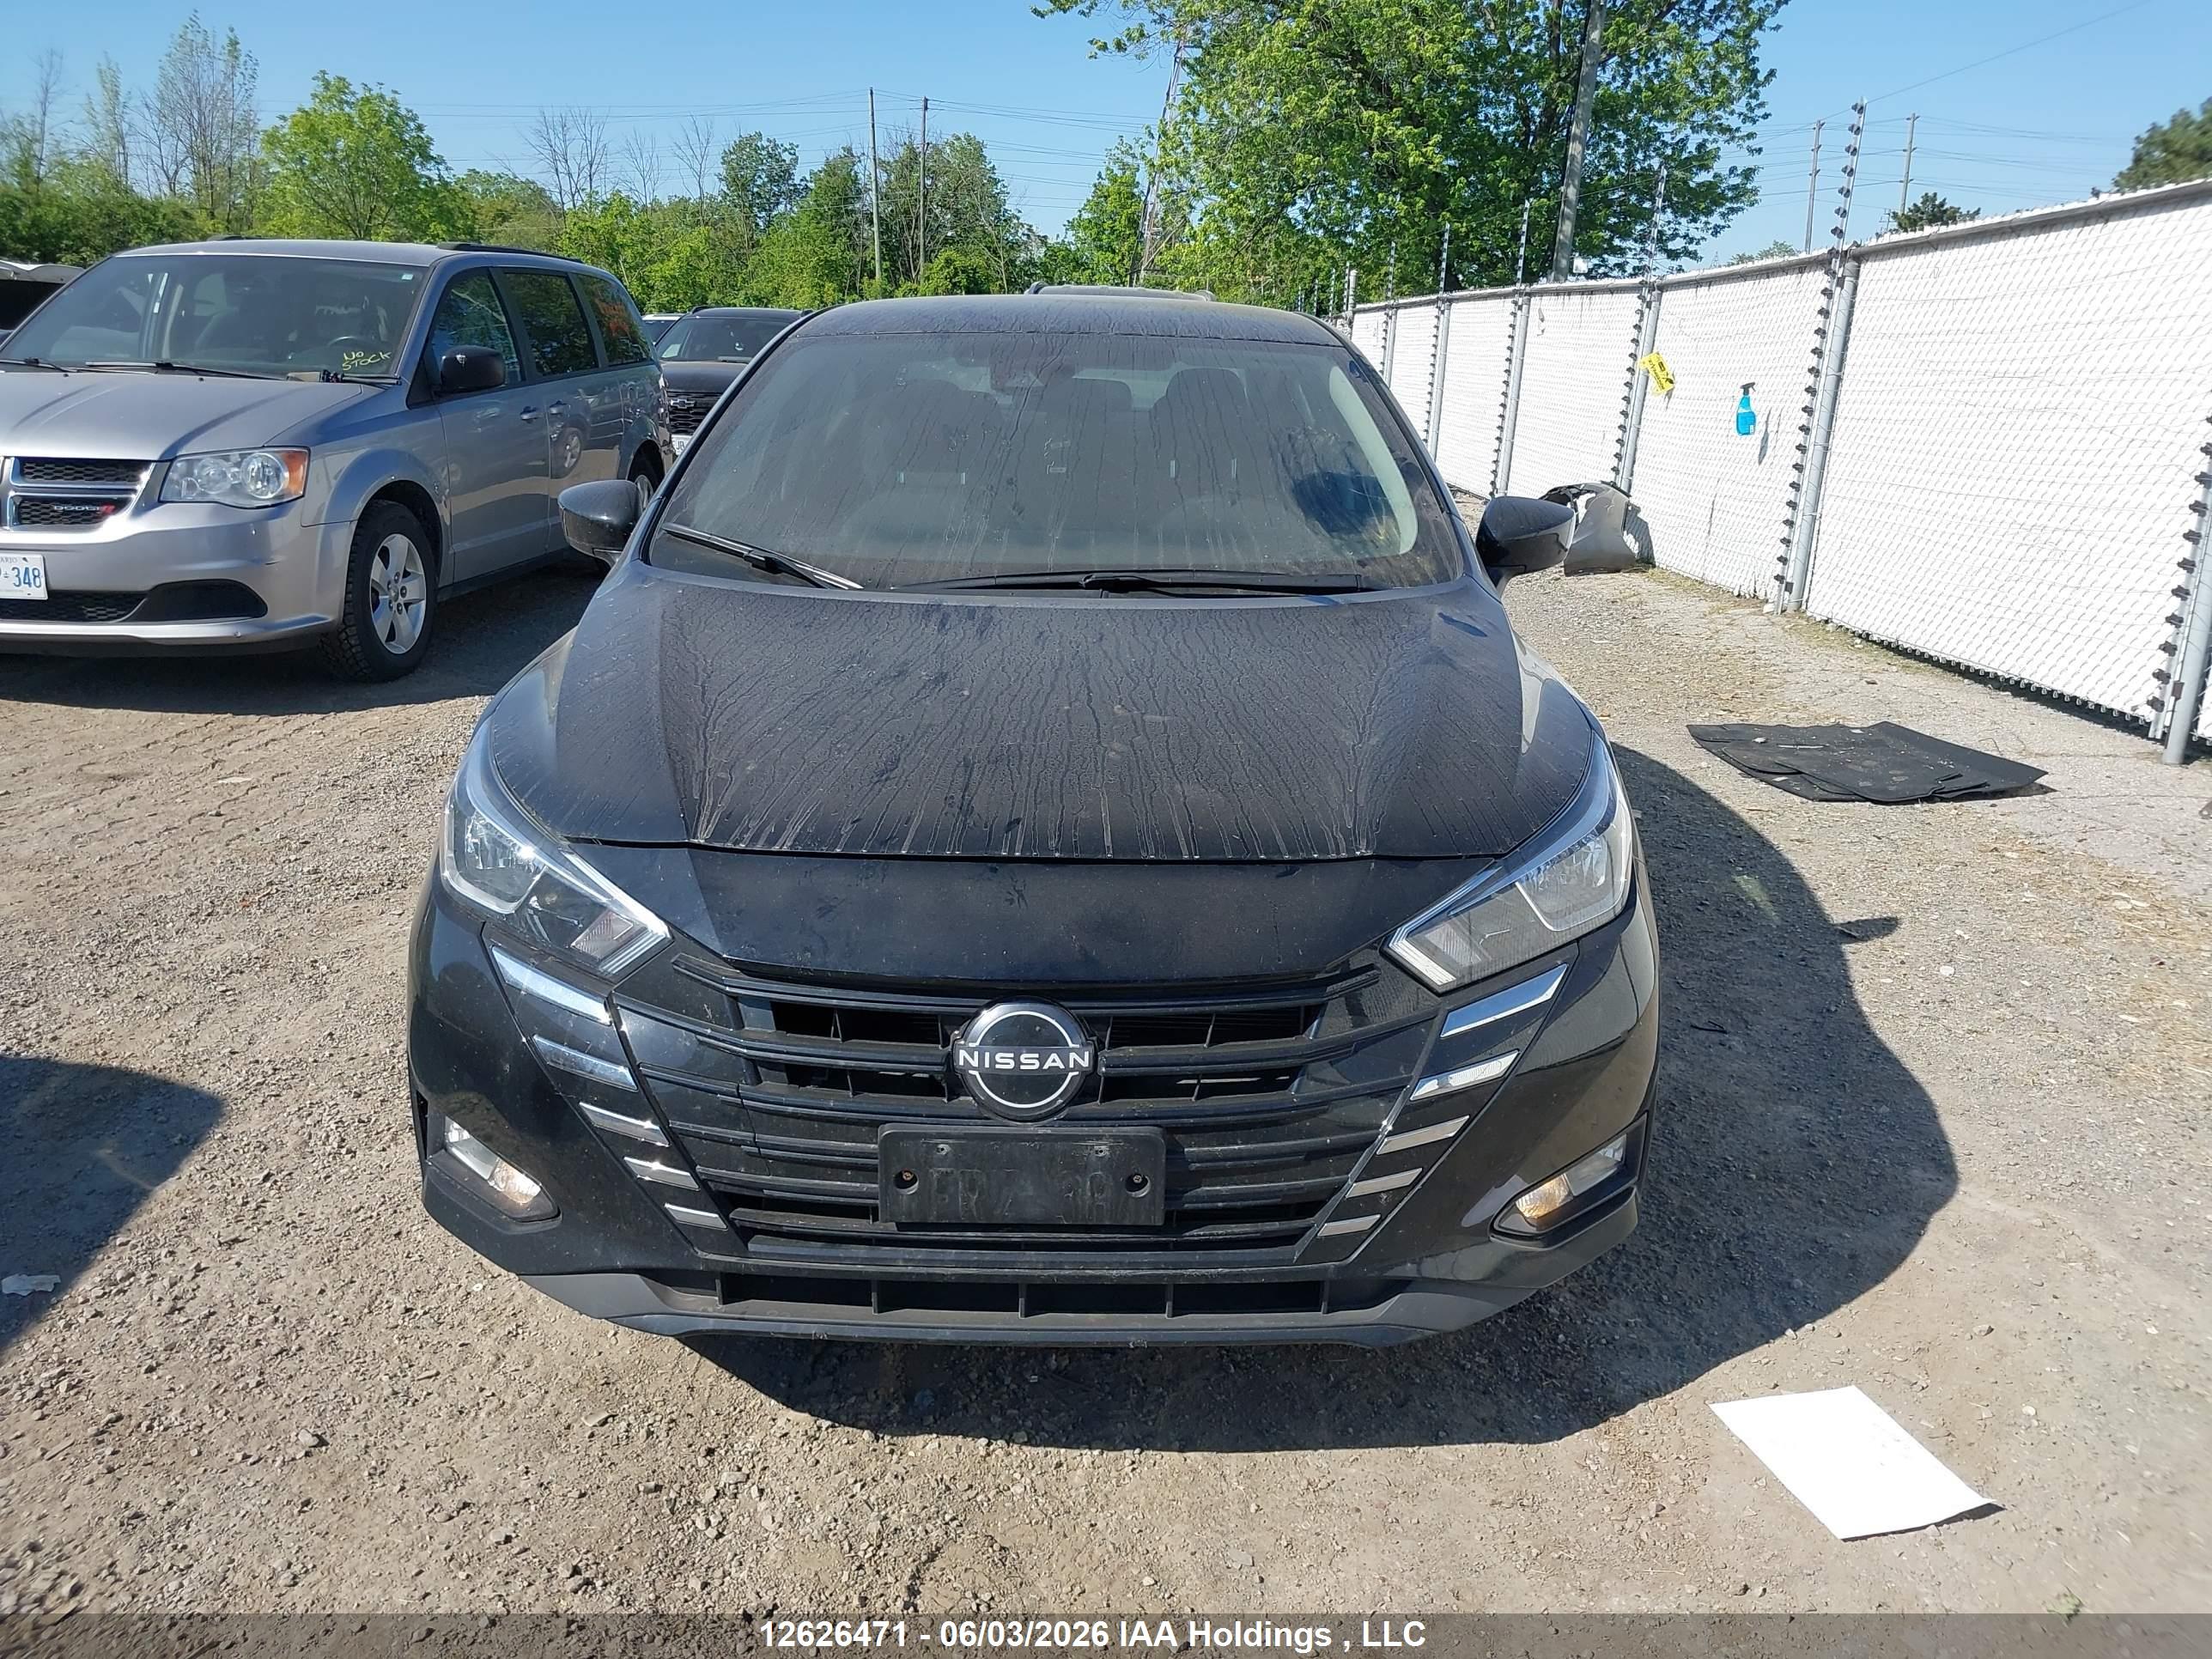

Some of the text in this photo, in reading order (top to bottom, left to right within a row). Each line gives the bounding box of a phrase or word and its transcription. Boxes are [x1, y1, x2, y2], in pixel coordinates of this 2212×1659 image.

[342, 351, 392, 371] STOCK
[11, 567, 42, 588] 348
[957, 1048, 1091, 1071] NISSAN
